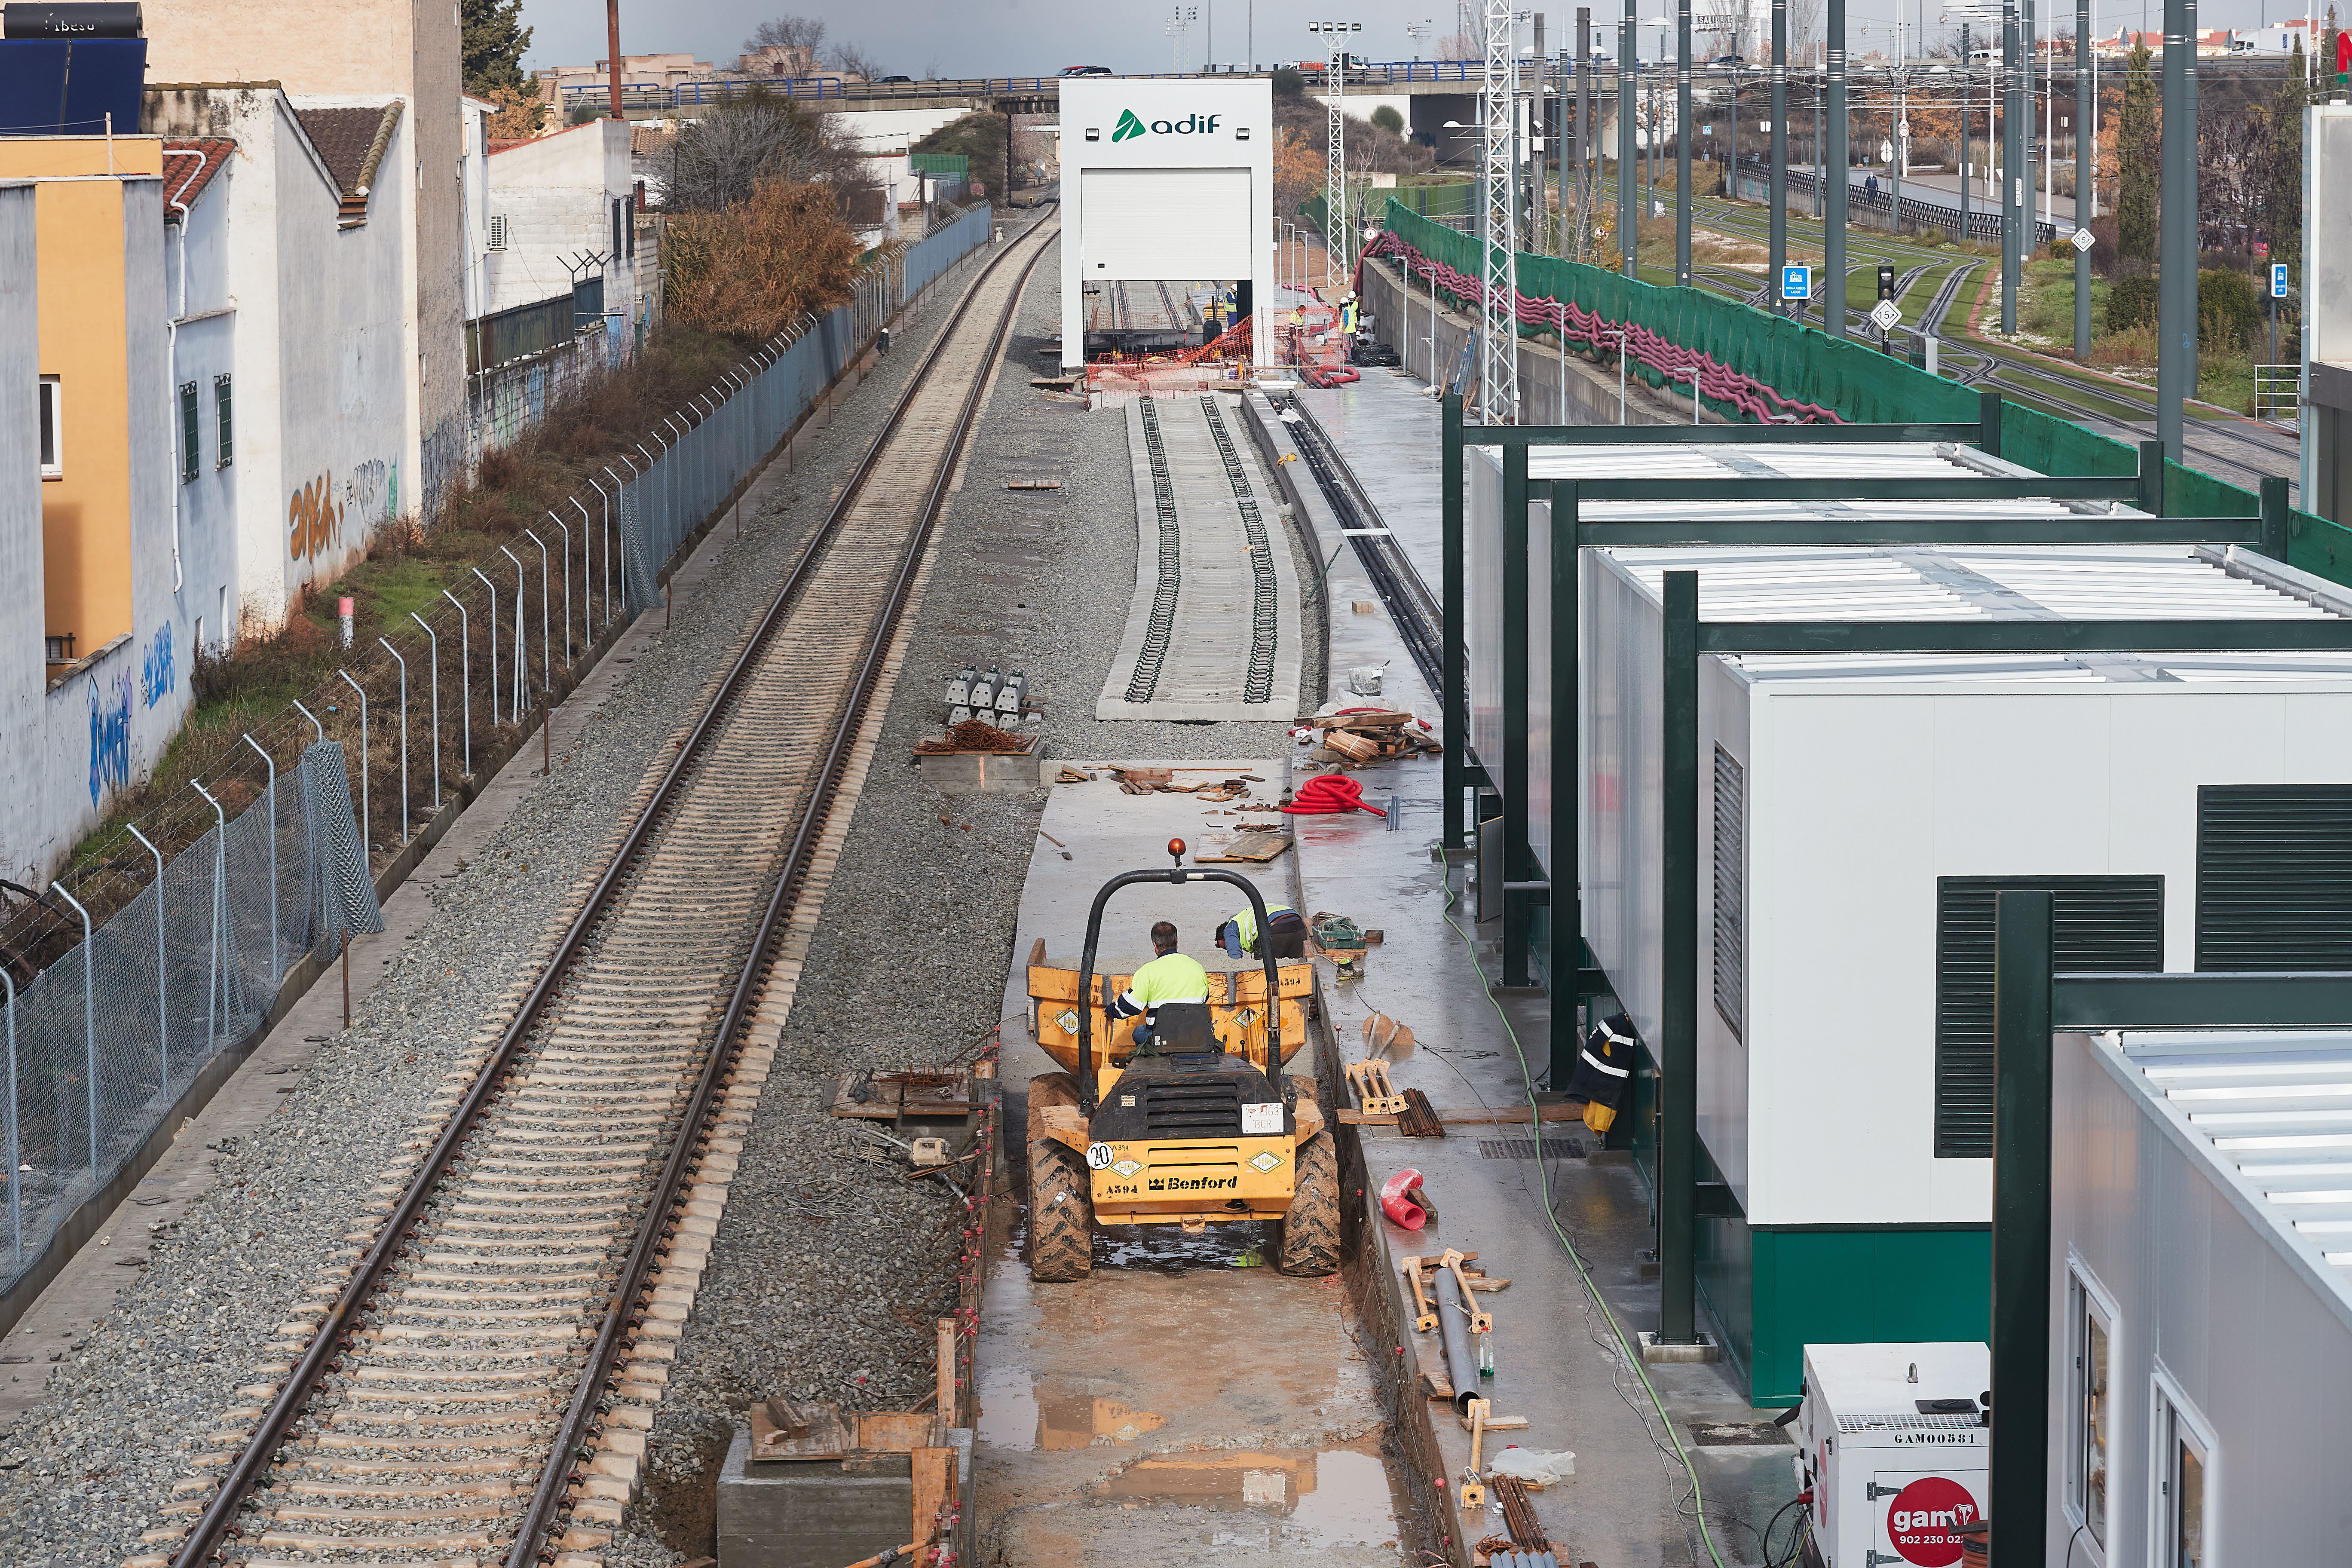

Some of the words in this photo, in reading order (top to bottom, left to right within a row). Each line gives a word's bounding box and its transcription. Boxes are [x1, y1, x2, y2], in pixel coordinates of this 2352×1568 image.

[1151, 113, 1222, 134] adif
[1064, 1017, 1078, 1029] HM
[1255, 1119, 1271, 1129] BCR
[1091, 1145, 1109, 1167] 20
[1119, 1162, 1135, 1171] HM
[1258, 1157, 1273, 1166] HM
[1167, 1176, 1237, 1190] Benford
[1106, 1185, 1138, 1194] A394
[1895, 1434, 1974, 1443] GAM00581
[1893, 1511, 1956, 1532] gam
[1900, 1536, 1920, 1544] 902
[1923, 1536, 1944, 1544] 230
